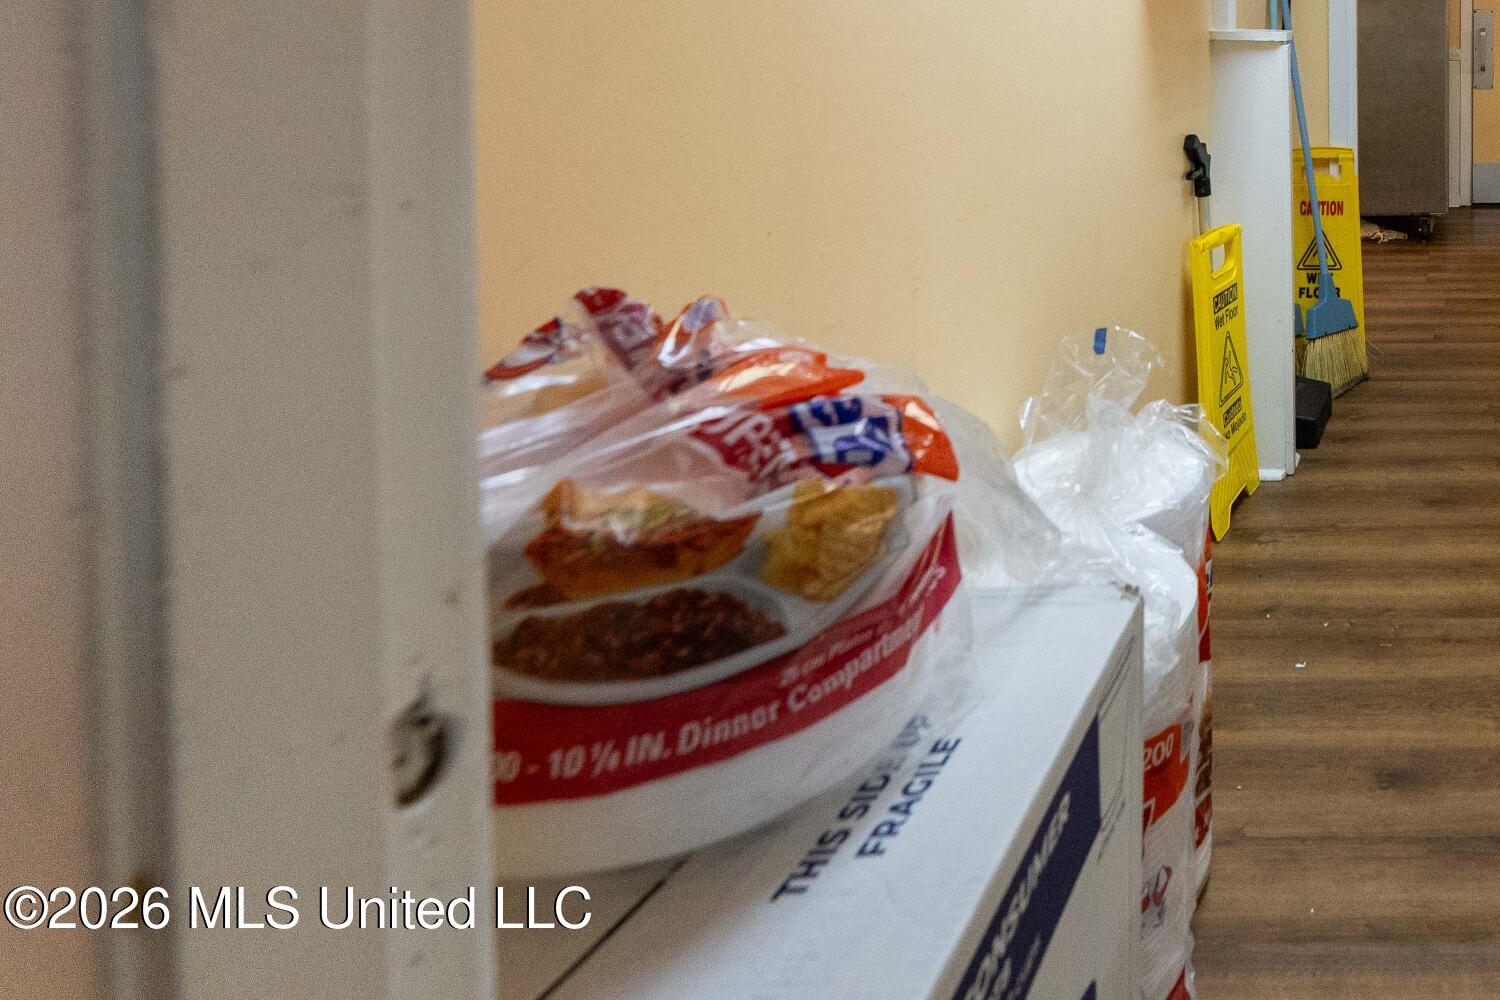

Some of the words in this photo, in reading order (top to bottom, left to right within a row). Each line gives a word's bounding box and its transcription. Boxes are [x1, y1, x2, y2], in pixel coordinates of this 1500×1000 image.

[1300, 201, 1344, 216] CATION
[1213, 284, 1238, 313] CAUTION
[1214, 313, 1224, 331] Wet
[1225, 305, 1238, 324] Floor
[1230, 412, 1246, 436] Mojado
[676, 702, 780, 757] Dinner
[855, 738, 962, 858] FRAGILE
[770, 828, 851, 904] THIS
